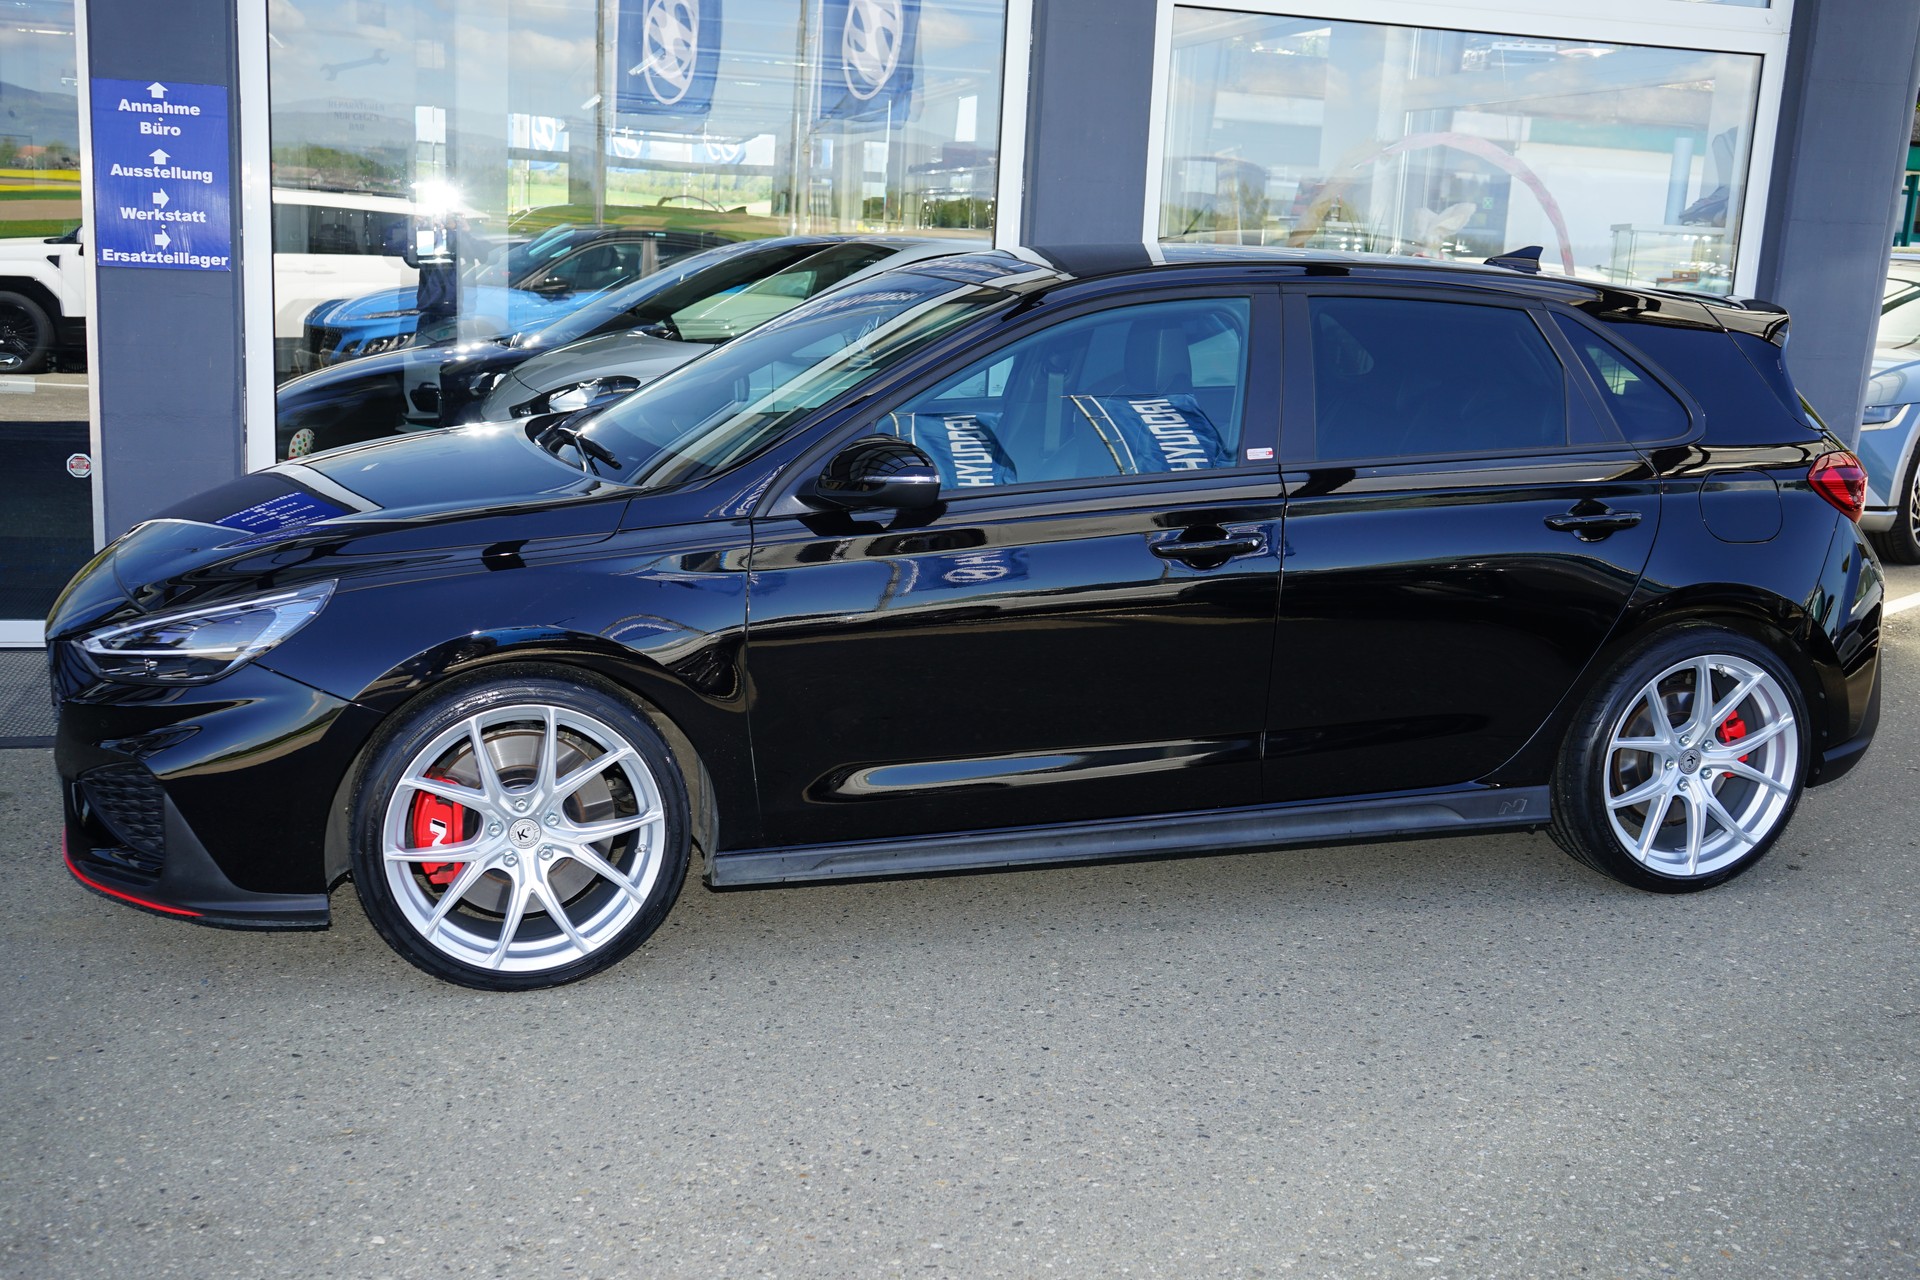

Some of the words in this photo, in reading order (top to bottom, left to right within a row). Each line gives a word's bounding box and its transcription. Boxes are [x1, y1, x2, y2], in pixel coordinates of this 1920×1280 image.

[118, 99, 201, 116] Annahme
[140, 122, 181, 136] Büro
[110, 164, 213, 184] Ausstellung
[120, 207, 206, 223] Werkstatt
[102, 249, 229, 268] Ersatzteillager
[1128, 399, 1209, 471] HYUNDAI
[943, 414, 995, 487] HYUNDAI
